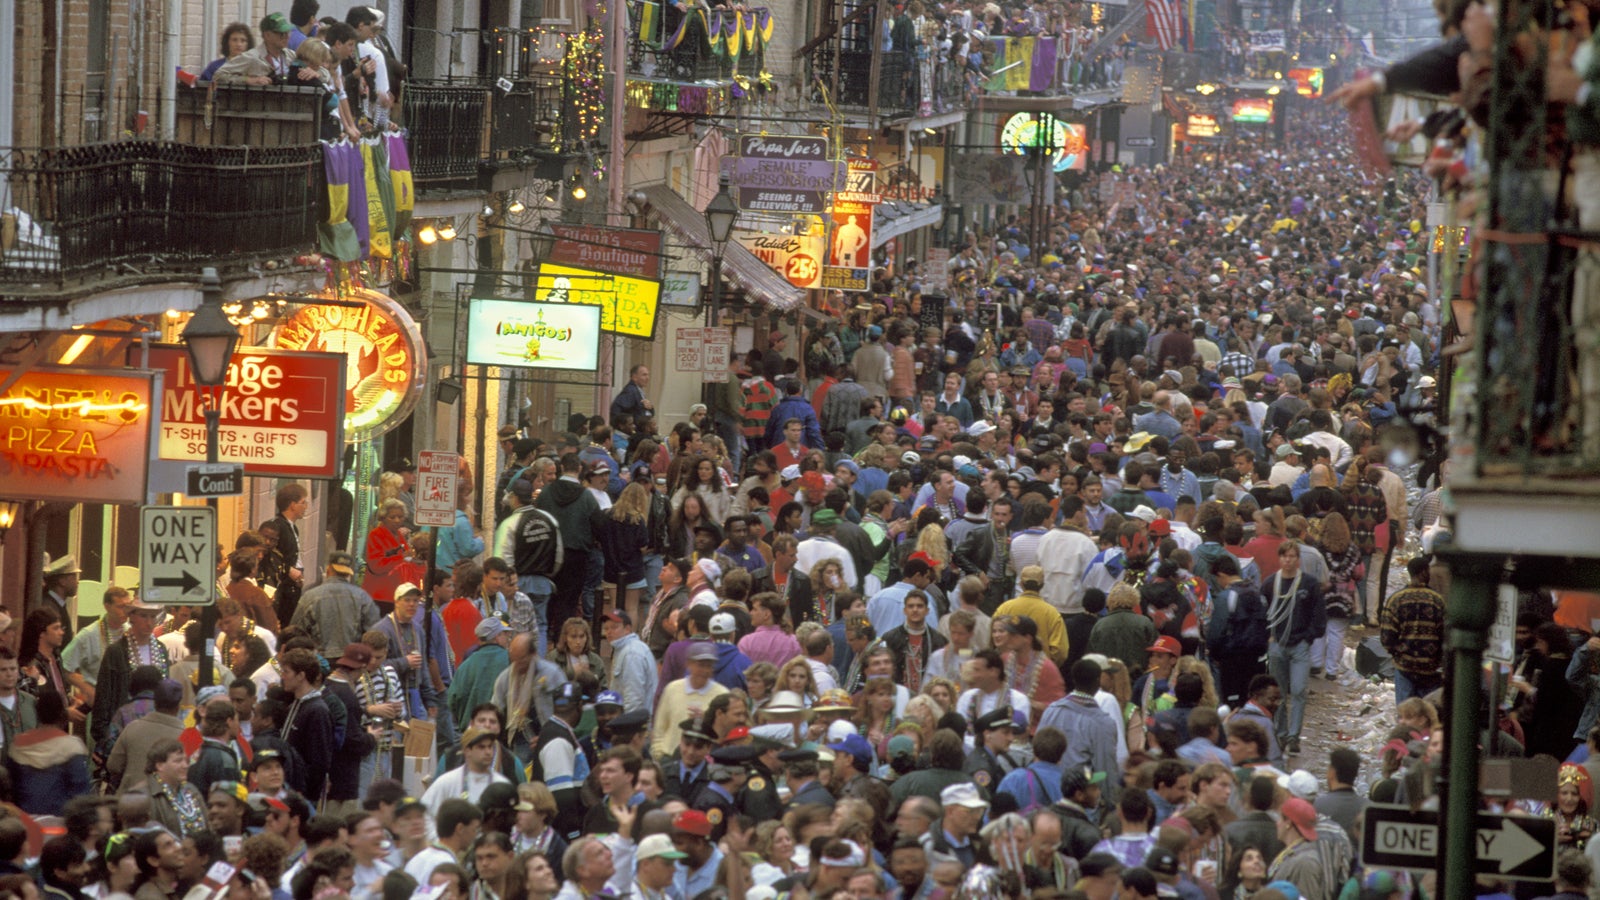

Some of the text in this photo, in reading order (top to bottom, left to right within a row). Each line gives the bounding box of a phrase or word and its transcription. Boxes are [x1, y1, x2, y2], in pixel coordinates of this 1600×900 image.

[747, 137, 821, 157] Papa Joe's
[750, 201, 799, 211] BELIEVING
[757, 192, 806, 203] SEEING IS
[578, 243, 648, 266] Boutique
[600, 278, 638, 296] THE
[580, 290, 650, 316] PANDA
[708, 346, 725, 355] FIRE
[706, 356, 725, 365] LANE
[177, 356, 284, 396] Iage
[164, 389, 299, 422] Makers
[8, 426, 97, 455] PIZZA
[164, 427, 297, 446] T-SHITS GIFTS
[187, 443, 275, 459] SOVENIRS
[420, 455, 431, 469] NO
[199, 474, 234, 493] Conti
[425, 477, 449, 489] FIRE
[423, 490, 449, 503] LANE
[152, 515, 205, 537] ONE
[149, 543, 207, 564] WAY
[1383, 826, 1434, 852] ONE
